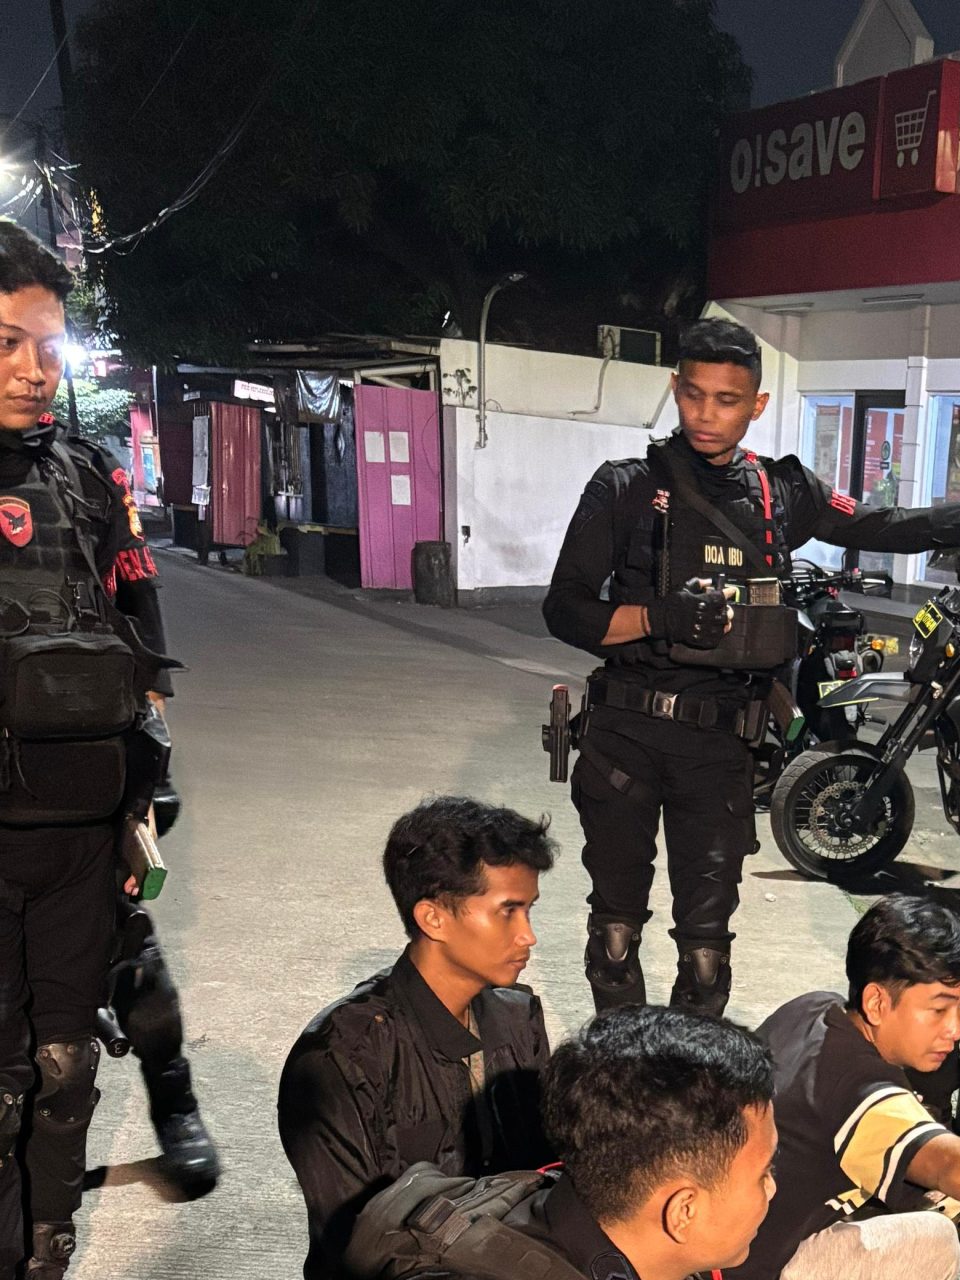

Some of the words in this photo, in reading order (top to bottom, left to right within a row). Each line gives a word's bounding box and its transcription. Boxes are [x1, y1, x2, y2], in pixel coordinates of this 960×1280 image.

[730, 111, 866, 194] o!save
[704, 544, 724, 565] DOA
[728, 545, 743, 567] IBU
